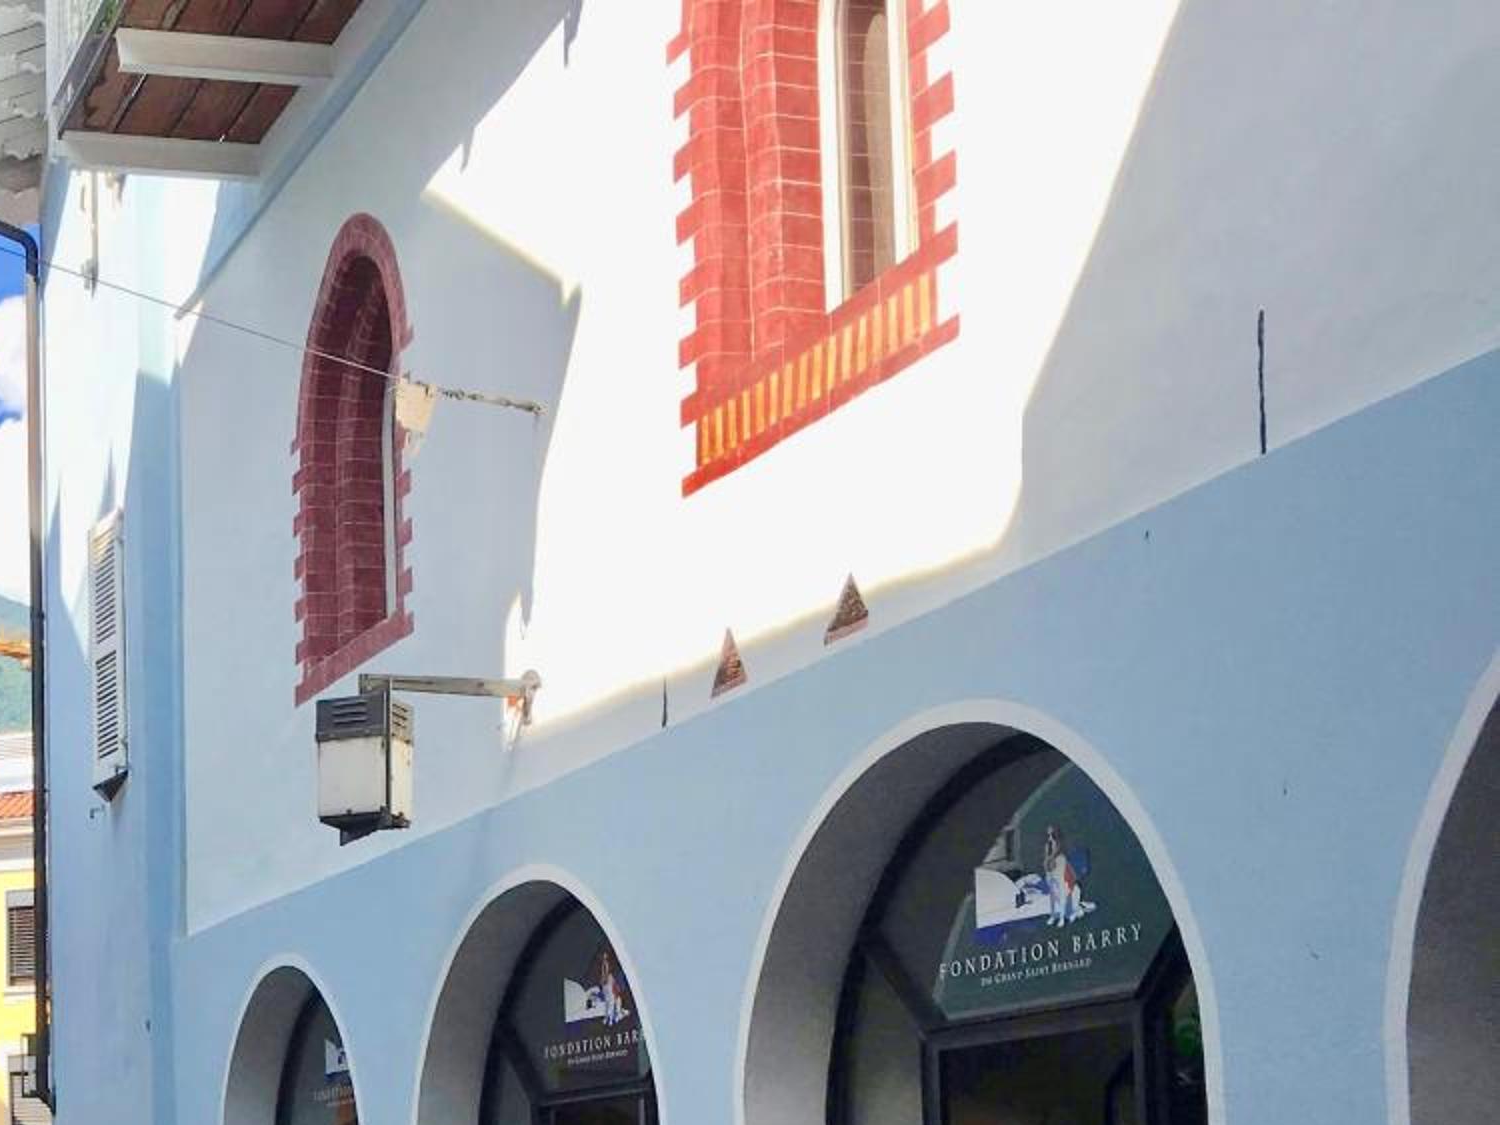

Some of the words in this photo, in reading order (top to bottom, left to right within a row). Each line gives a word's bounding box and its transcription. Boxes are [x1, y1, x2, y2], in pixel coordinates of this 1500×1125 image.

[938, 939, 1061, 981] FONDATION
[1072, 923, 1142, 954] BARRY
[543, 1034, 612, 1059] FONDATION
